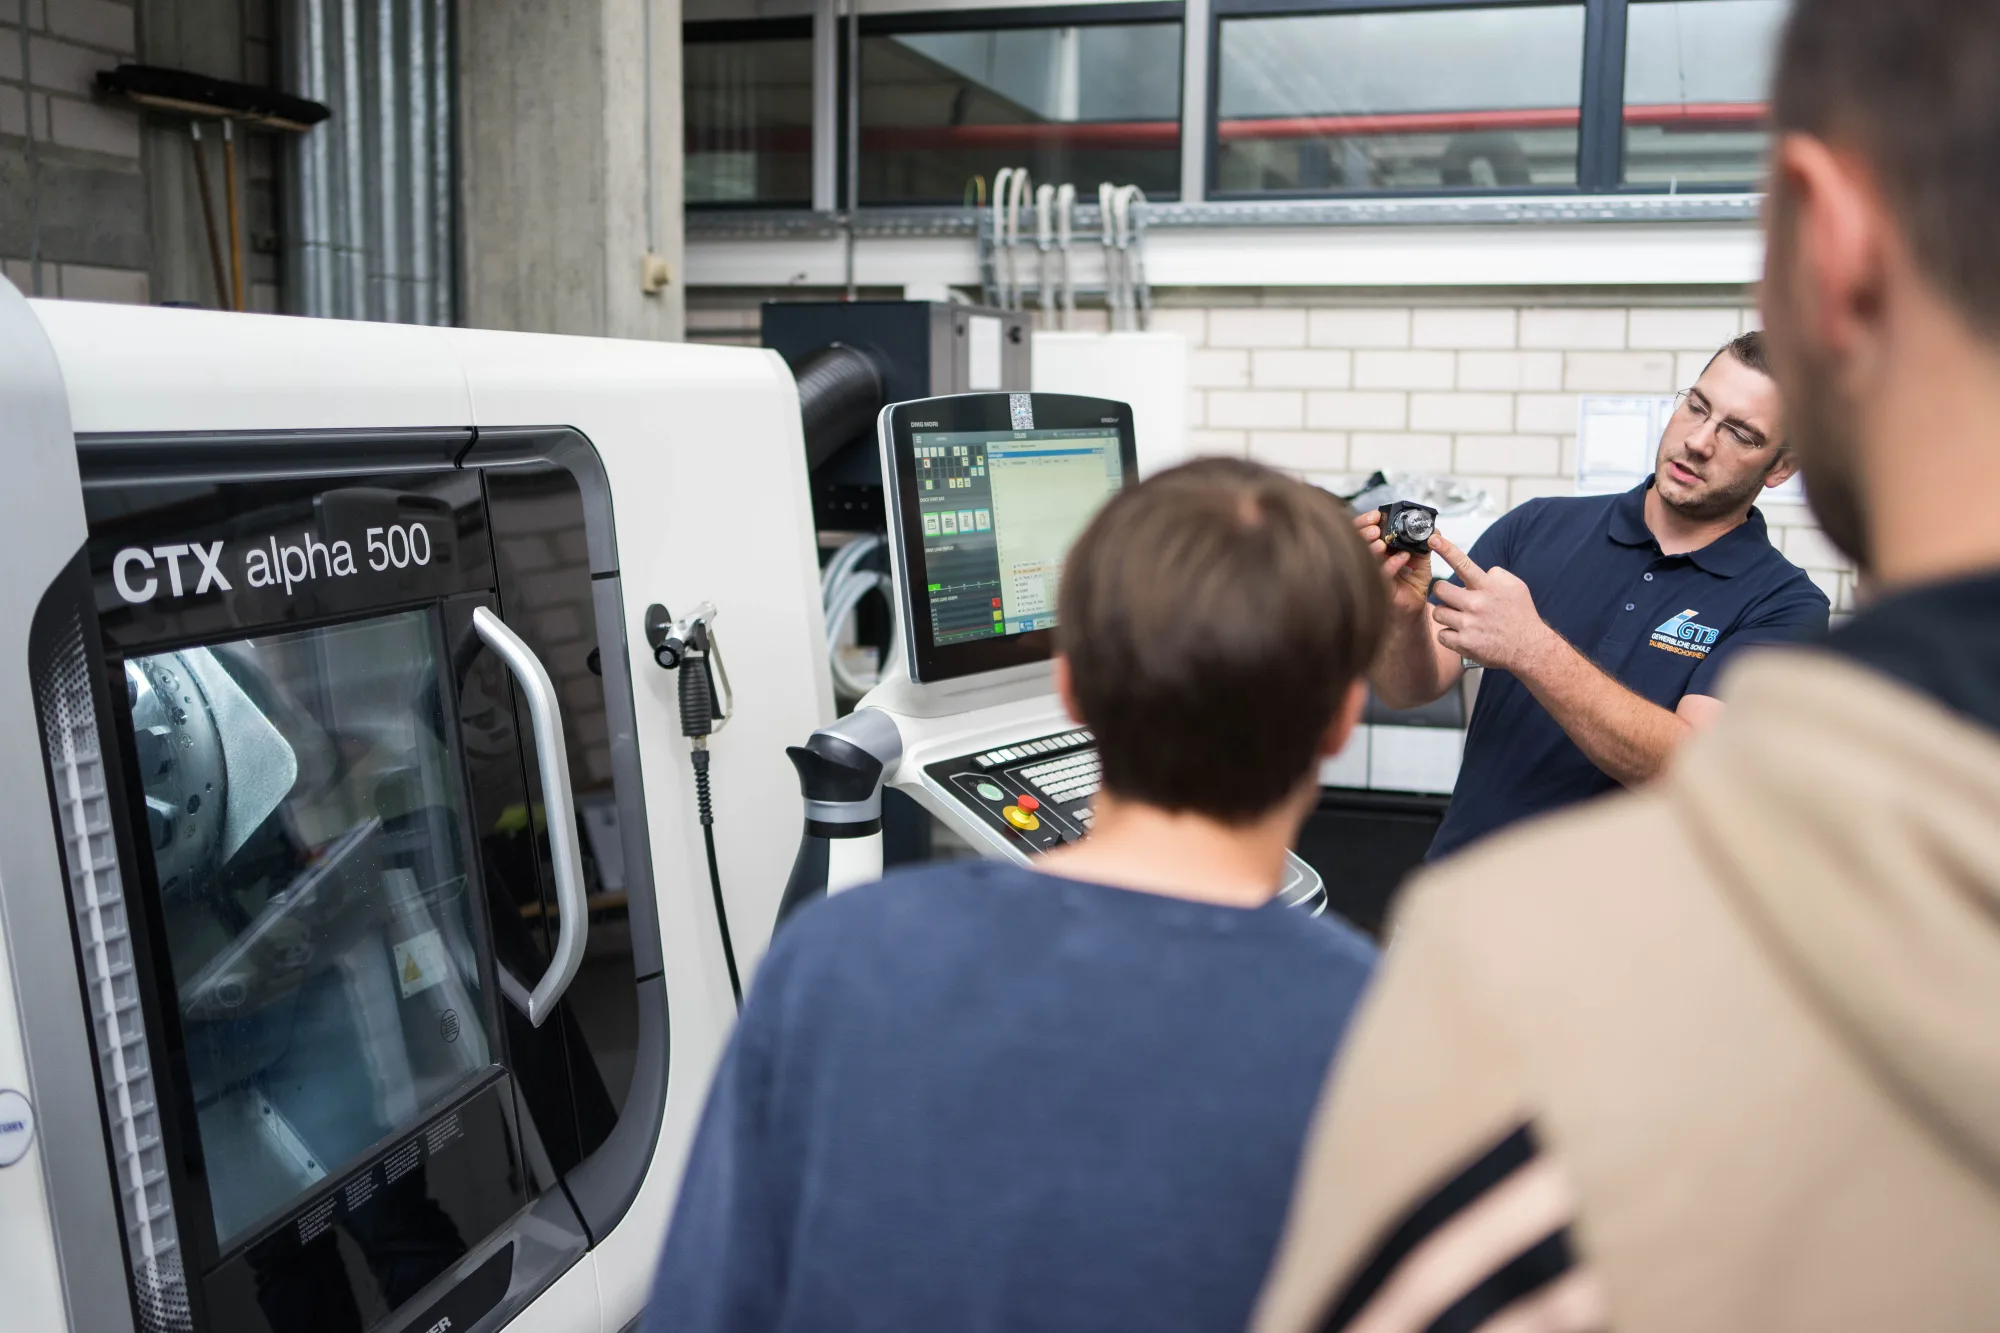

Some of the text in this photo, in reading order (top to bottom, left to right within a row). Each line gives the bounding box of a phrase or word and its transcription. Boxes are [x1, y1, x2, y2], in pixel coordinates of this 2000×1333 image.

[112, 522, 431, 604] CTX alpha 500
[1651, 632, 1712, 654] GEWERBLICHE SCHULE
[1678, 621, 1719, 644] GTB
[425, 1316, 452, 1333] ER
